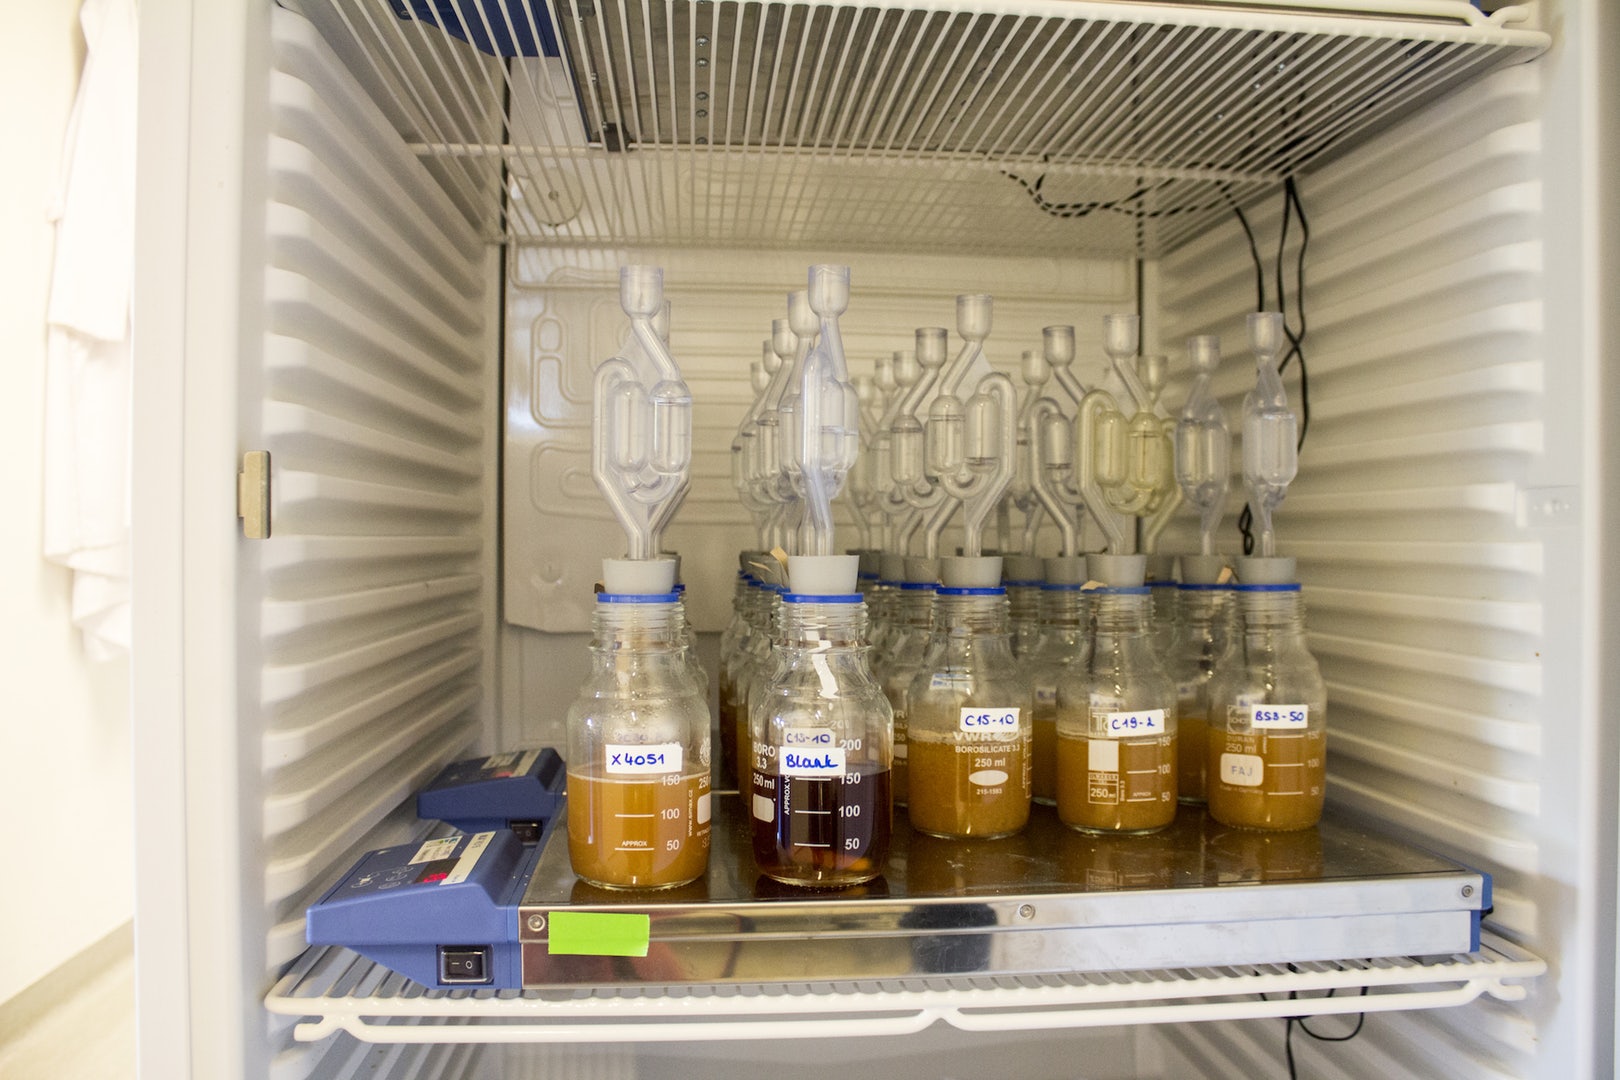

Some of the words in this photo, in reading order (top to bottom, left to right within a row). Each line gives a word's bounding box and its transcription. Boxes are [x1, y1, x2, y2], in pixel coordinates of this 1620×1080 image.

[965, 713, 1015, 726] C15-10
[839, 739, 862, 751] 200
[954, 744, 1010, 754] BOROSILICATE
[1225, 743, 1242, 753] 250
[785, 753, 838, 769] Blank
[975, 758, 992, 768] 250
[994, 757, 1006, 767] ml
[1158, 763, 1171, 775] 100
[662, 775, 680, 787] 150
[839, 772, 861, 785] 150
[1090, 788, 1109, 798] 250
[1161, 791, 1171, 803] 50
[661, 807, 680, 820] 100
[838, 804, 861, 818] 100
[666, 839, 680, 851] 50
[844, 837, 860, 851] 50
